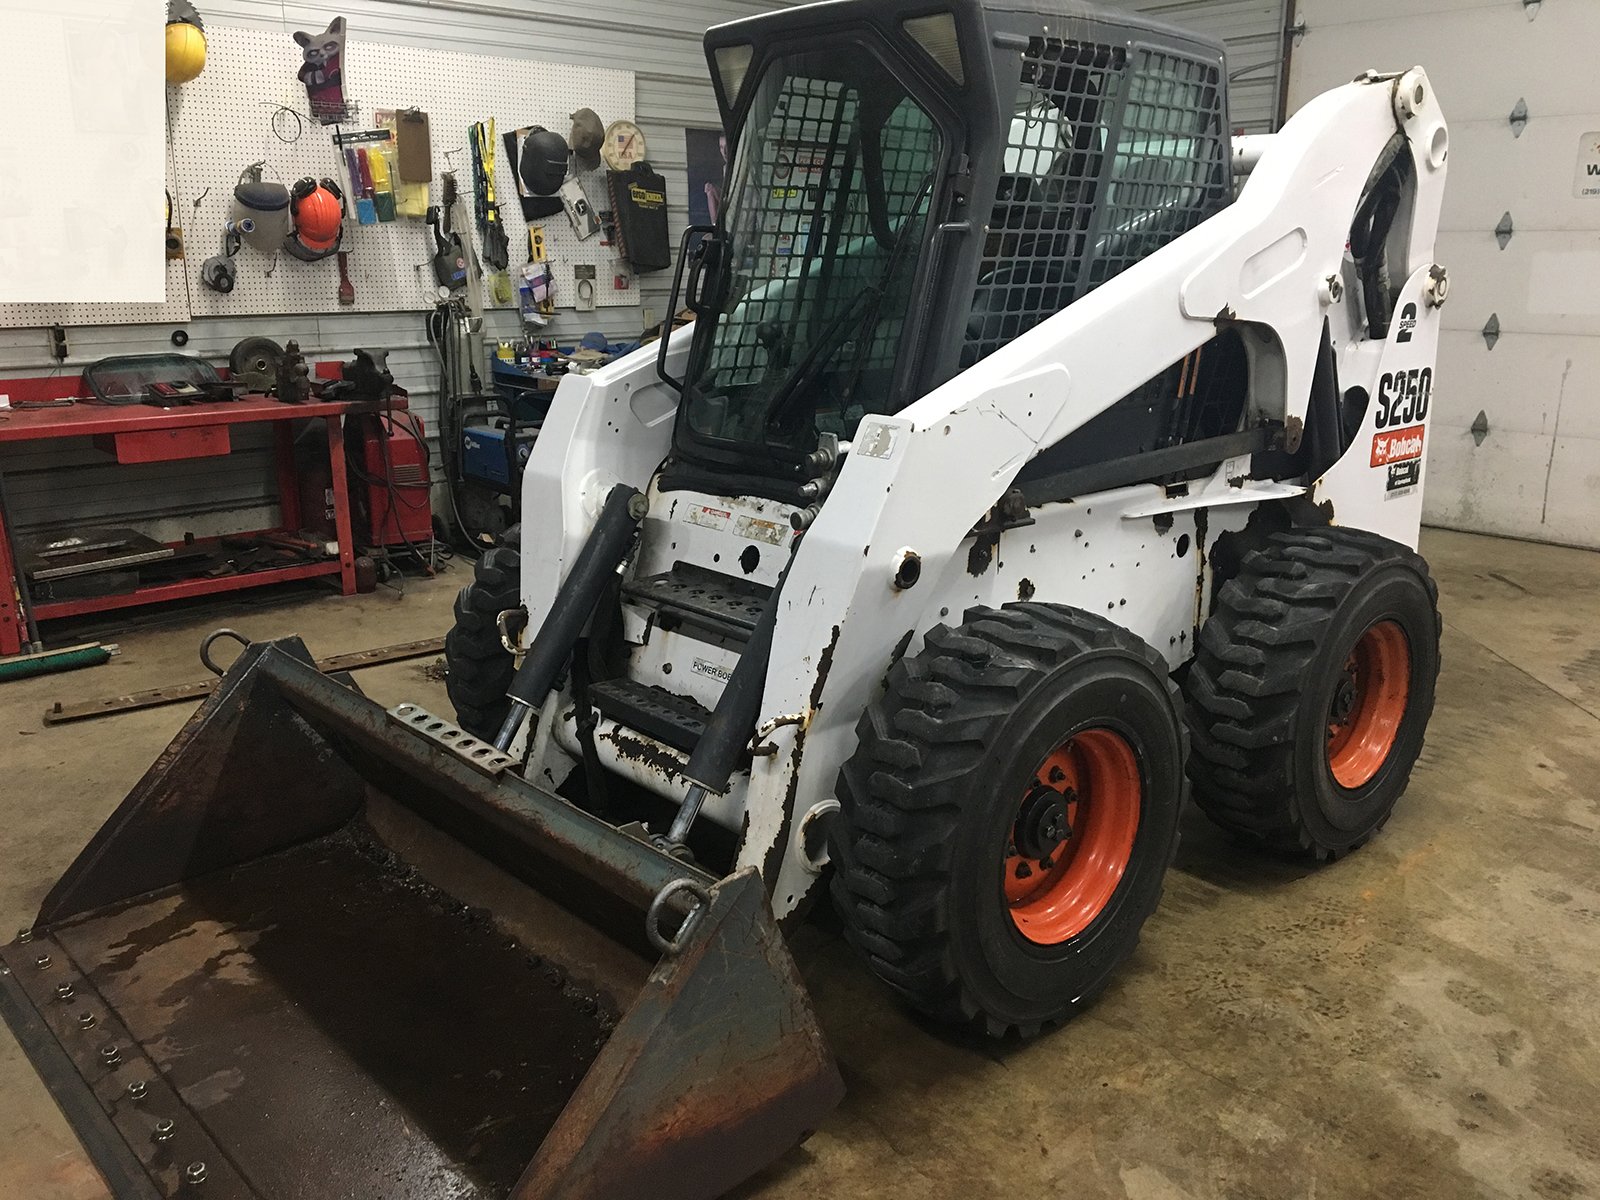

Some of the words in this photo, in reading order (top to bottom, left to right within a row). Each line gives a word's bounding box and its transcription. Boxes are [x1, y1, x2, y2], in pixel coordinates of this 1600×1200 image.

[1396, 302, 1417, 344] 2
[1399, 319, 1416, 329] SPEED
[1375, 366, 1432, 429] S250
[693, 661, 717, 676] POWER
